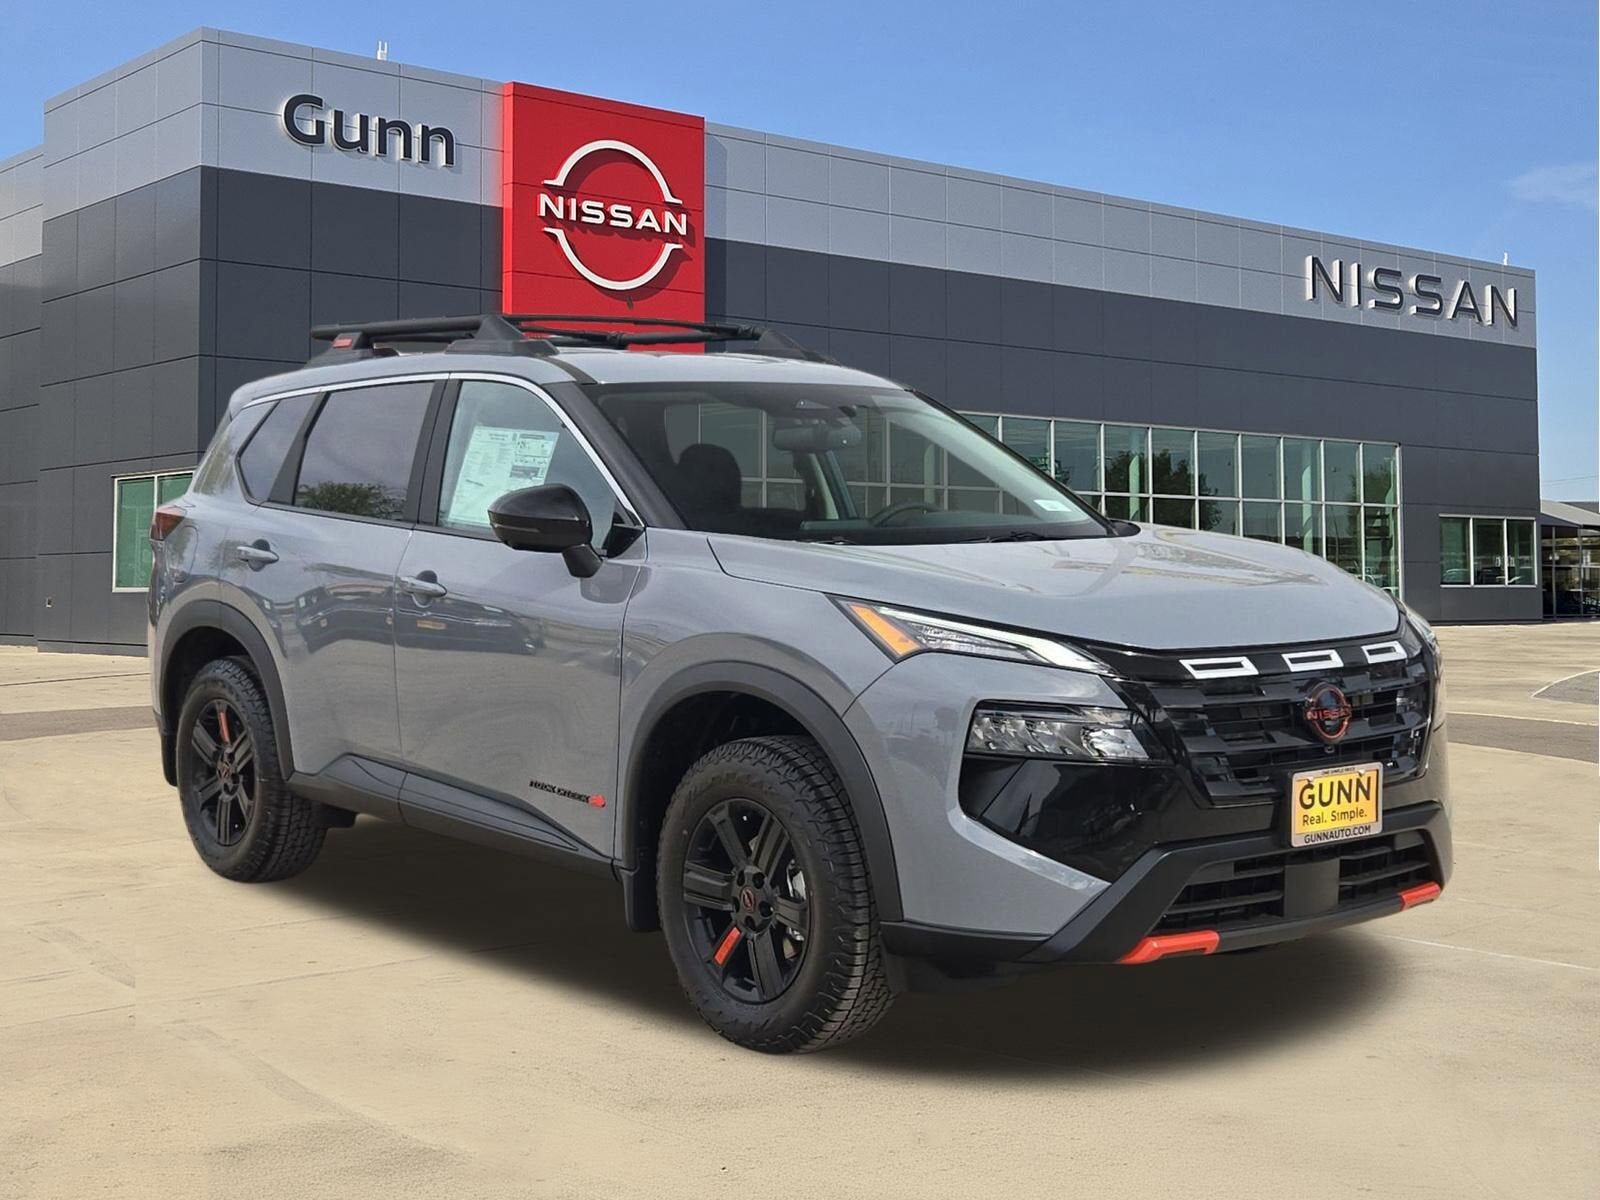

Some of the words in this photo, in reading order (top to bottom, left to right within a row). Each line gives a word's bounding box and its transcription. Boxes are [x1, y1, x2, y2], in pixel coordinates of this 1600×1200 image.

[282, 93, 455, 167] Gunn
[537, 192, 688, 236] NISSAN
[1305, 254, 1518, 328] NISSAN
[1299, 775, 1371, 810] GUNN
[1302, 811, 1327, 827] Real.
[1330, 807, 1368, 823] Simple.
[1303, 824, 1372, 845] GUNNAUTO.COM
